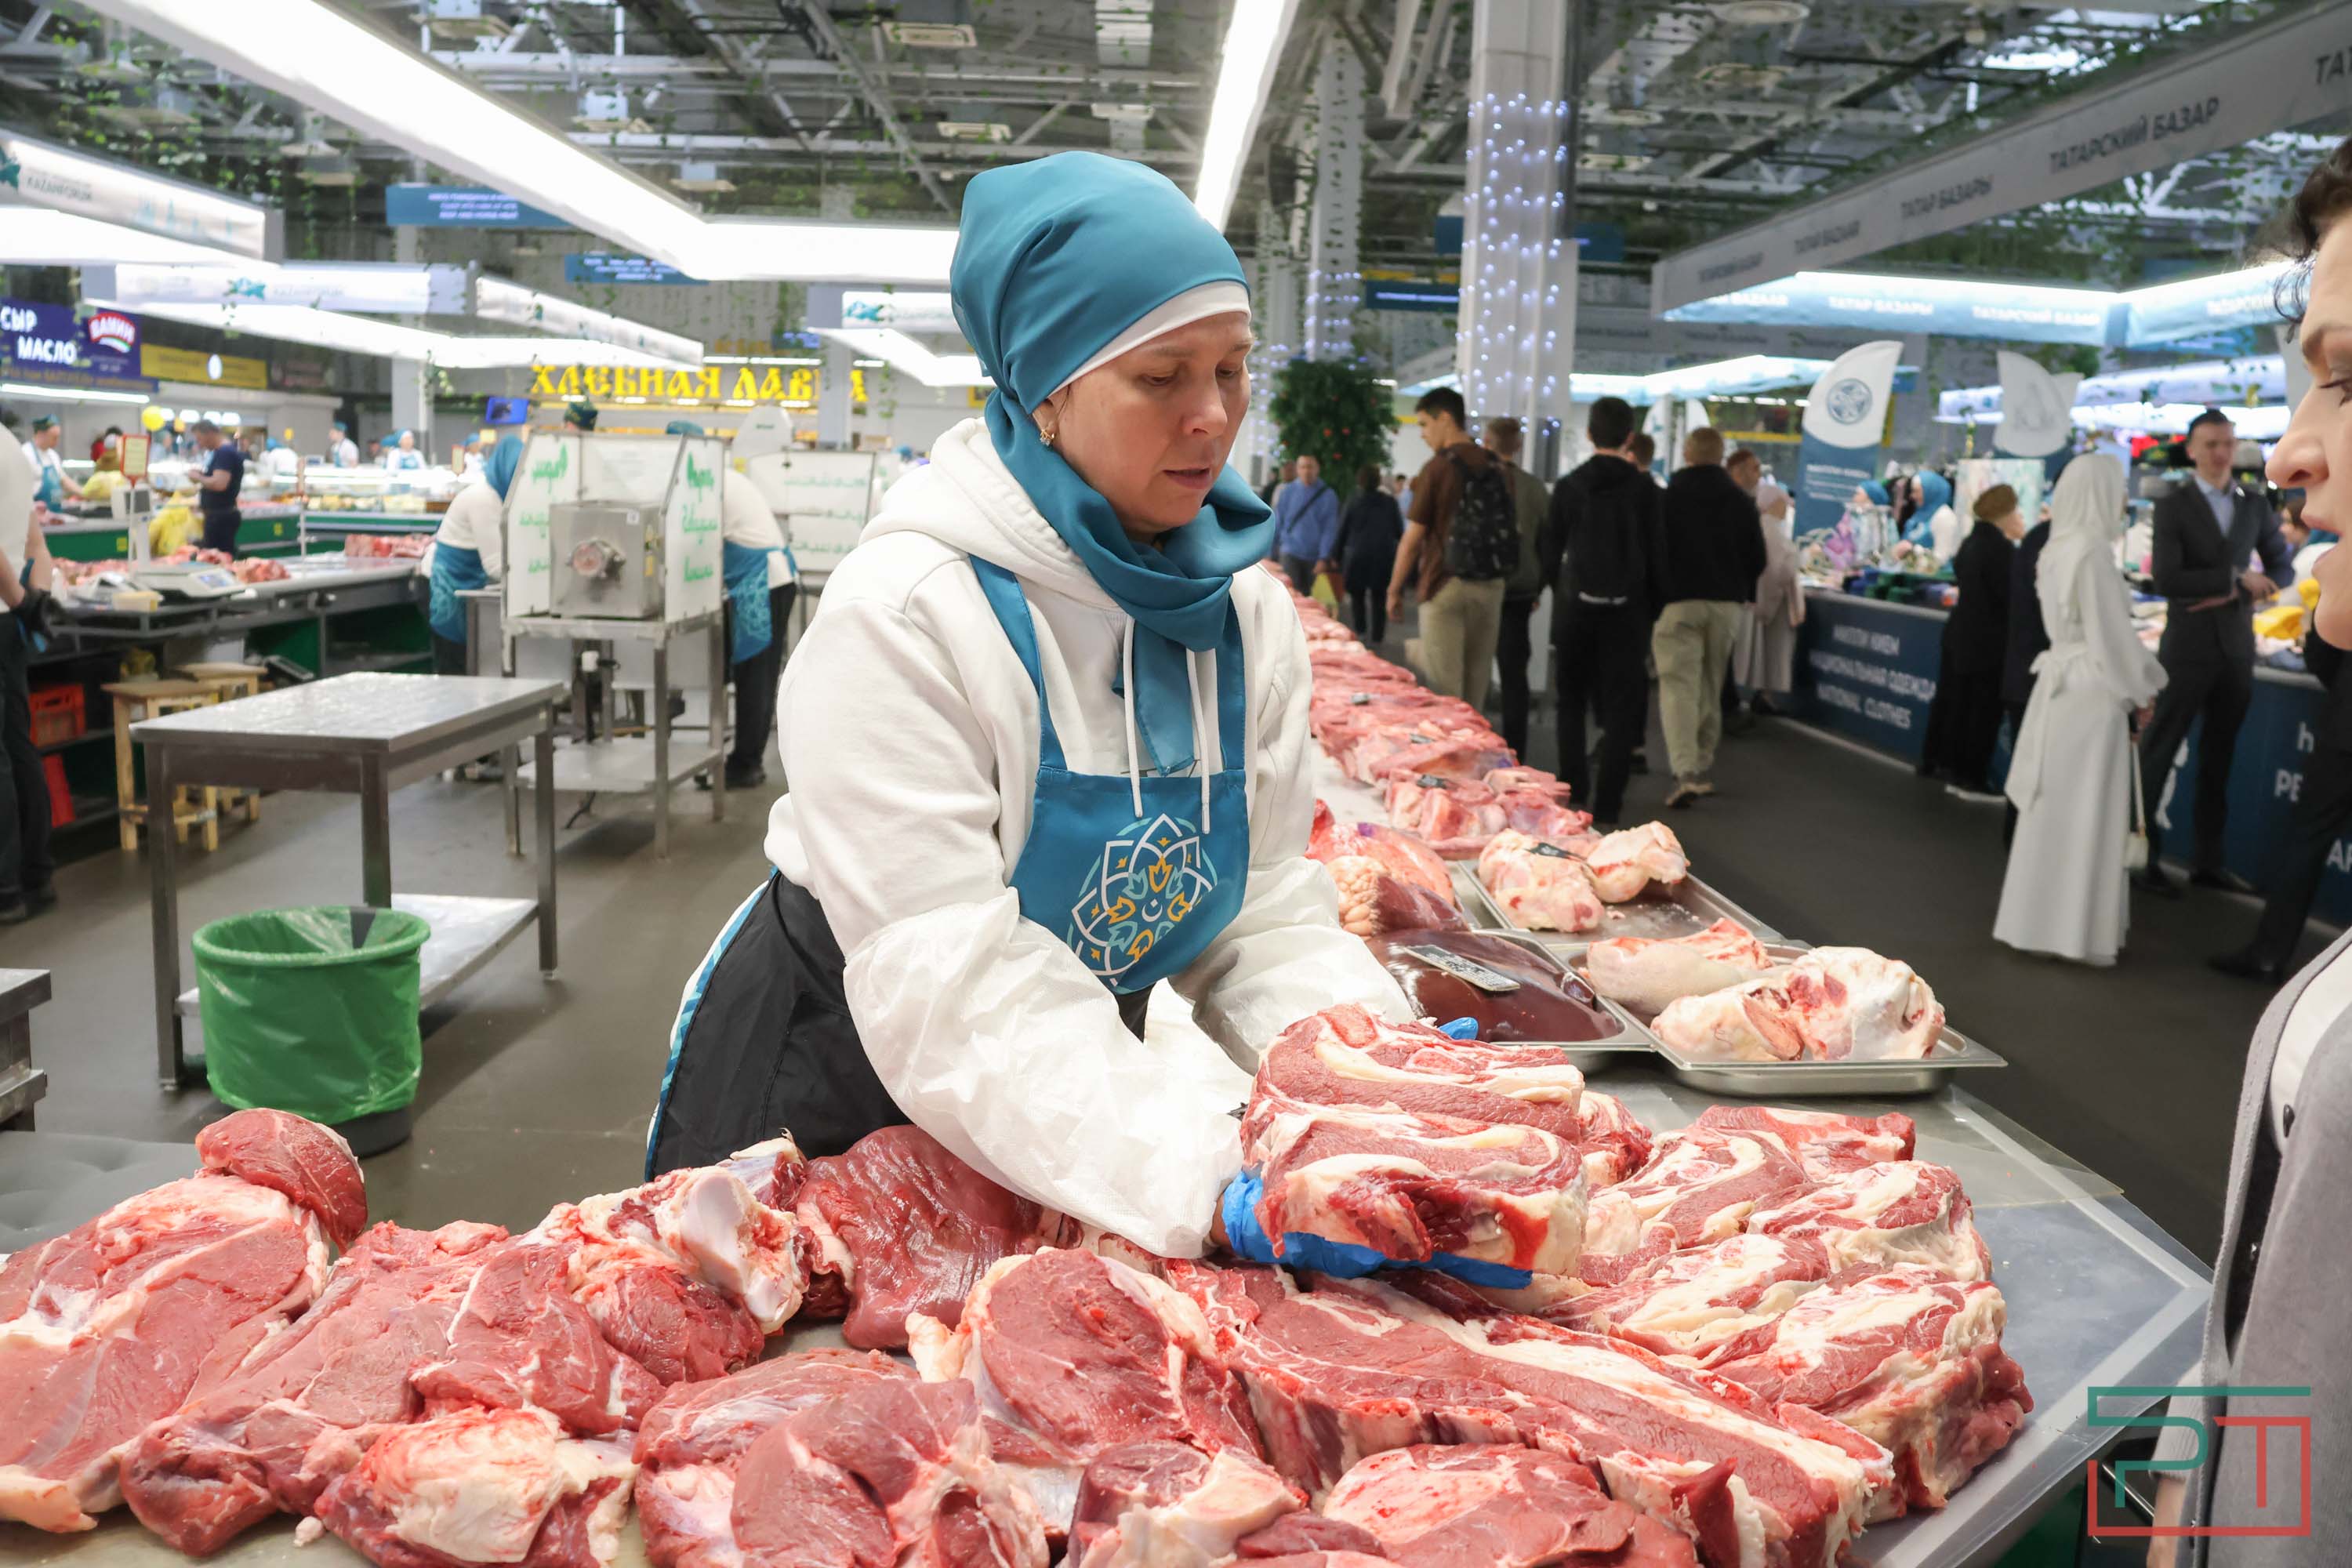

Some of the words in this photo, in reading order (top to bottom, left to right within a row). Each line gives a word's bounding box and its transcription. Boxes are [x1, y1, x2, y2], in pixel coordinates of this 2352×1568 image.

[2049, 114, 2148, 173] ТАТАРСКИЙ
[2153, 96, 2220, 140] БАЗАР
[0, 305, 38, 332] СЫР
[16, 336, 78, 365] МАСЛО
[732, 367, 869, 401] ЛАВА
